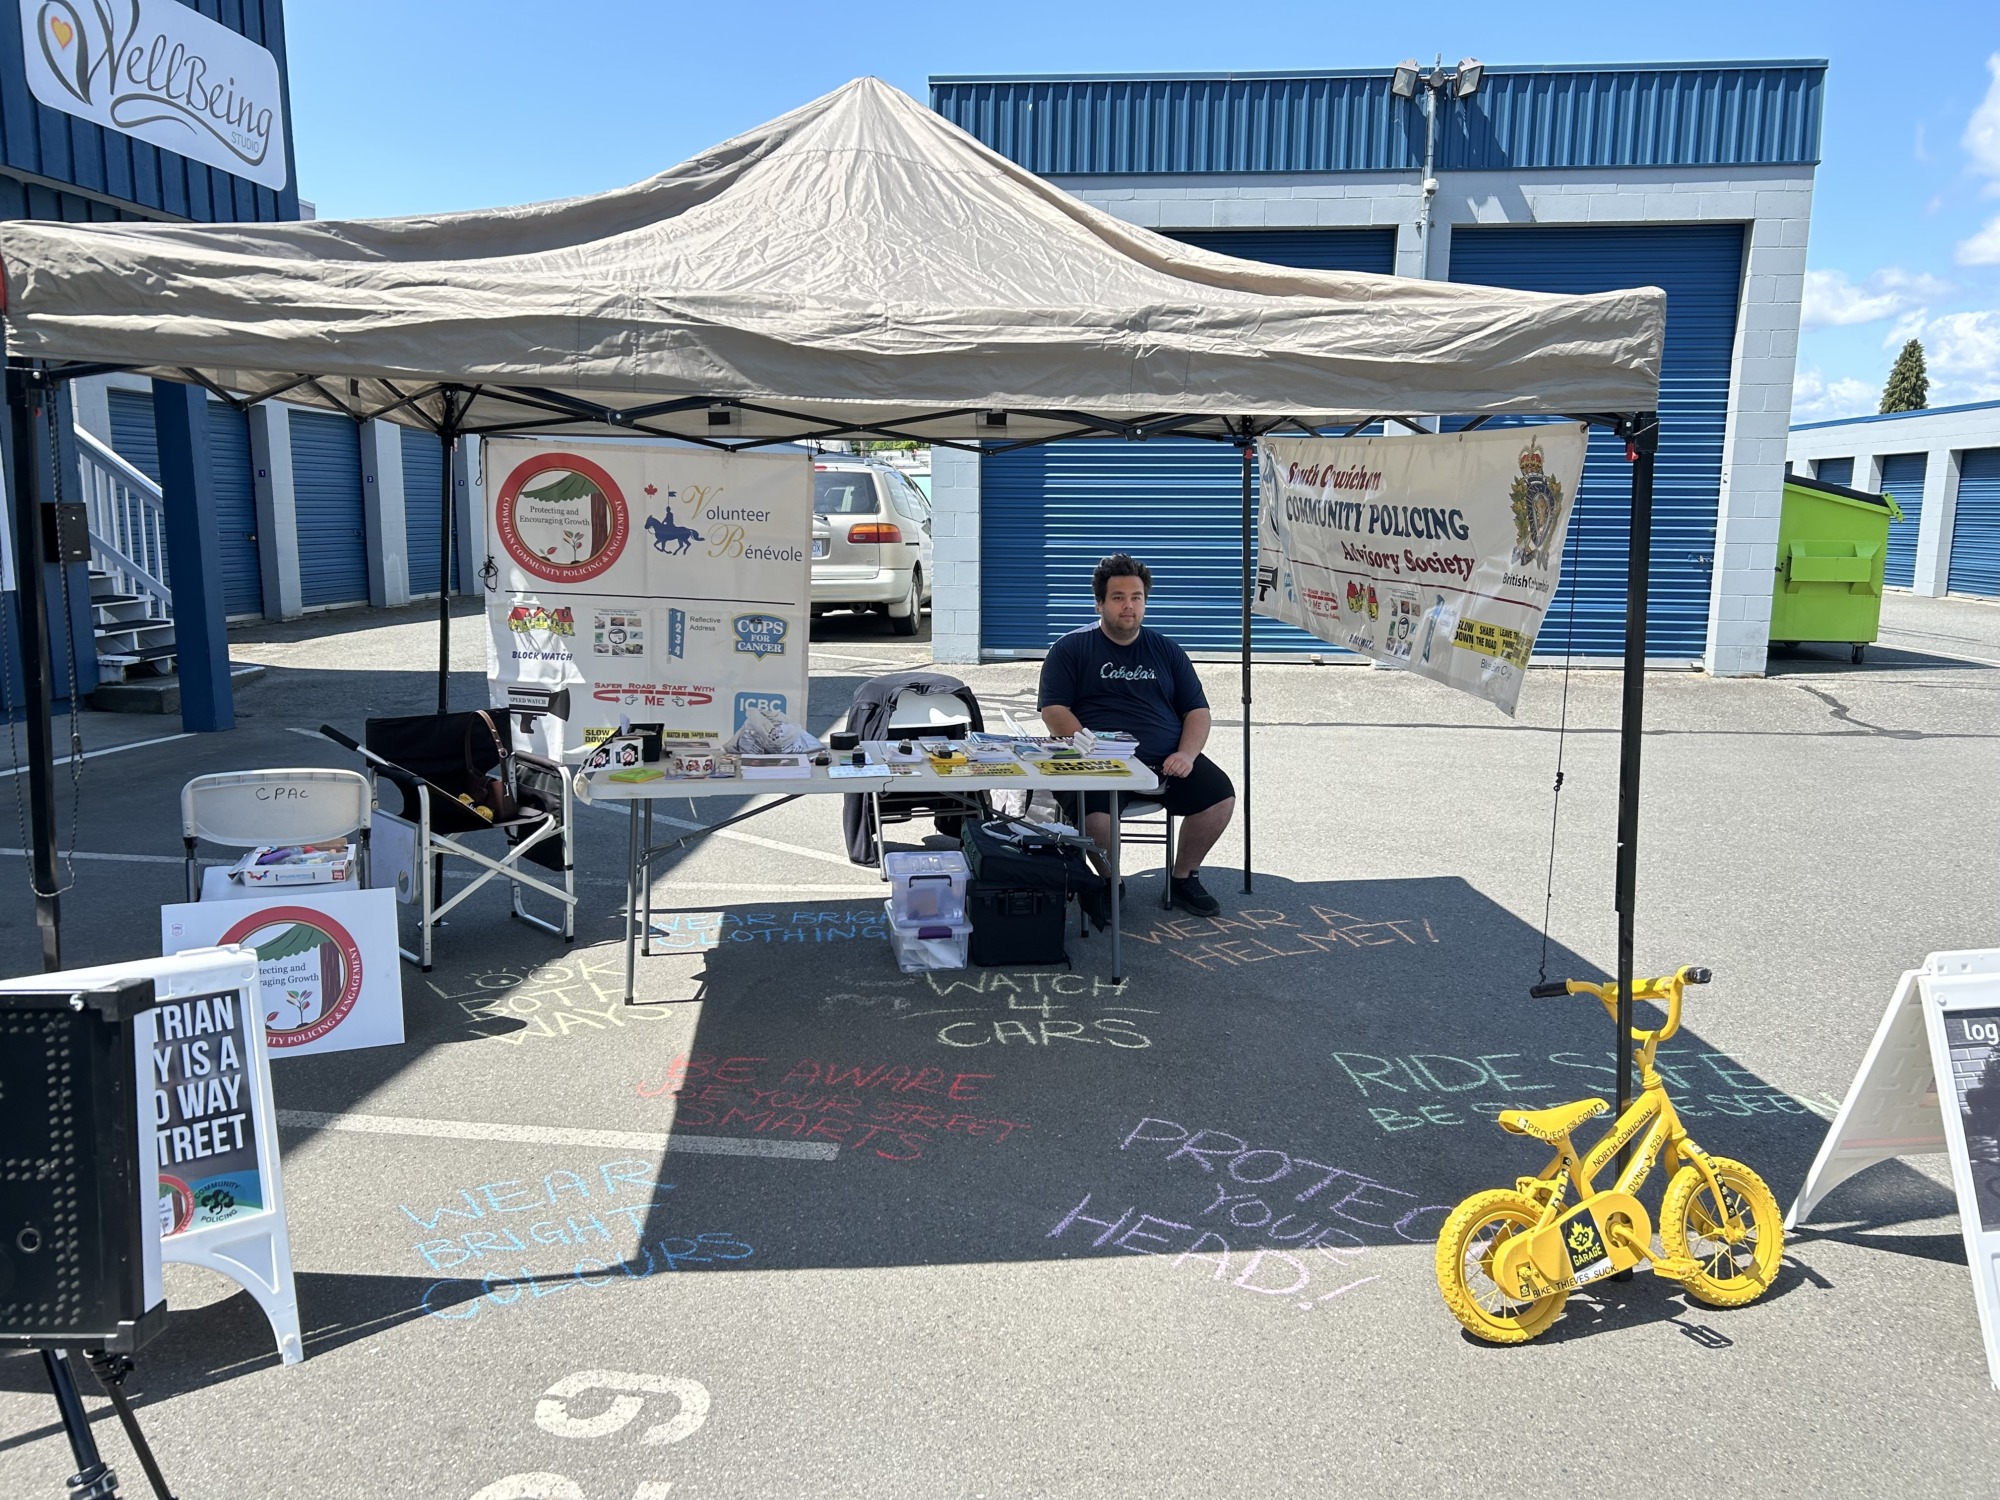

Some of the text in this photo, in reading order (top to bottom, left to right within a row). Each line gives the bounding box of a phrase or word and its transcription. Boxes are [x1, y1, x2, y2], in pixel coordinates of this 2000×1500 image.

[37, 0, 272, 165] WellBeing
[231, 131, 260, 153] STUDIO
[1289, 462, 1382, 491] South Cowichan
[530, 506, 579, 517] Protecting and
[681, 485, 771, 522] Volunteer
[519, 515, 590, 527] Encouraging Growth
[1286, 495, 1470, 541] COMMUNITY POLICING
[502, 496, 626, 577] COWICHAN COMMUNITY POLICING & ENGAGEMENT
[707, 523, 803, 562] Bénévole
[1341, 541, 1475, 582] Advisory Society
[1502, 572, 1528, 588] British
[674, 611, 683, 656] 1234
[689, 616, 721, 624] Reflective
[689, 624, 716, 632] Address
[737, 619, 784, 635] COPS
[1479, 625, 1496, 638] SHARE
[1500, 628, 1513, 637] LEAVE
[737, 641, 782, 653] CANCER
[750, 634, 770, 643] FOR
[1475, 636, 1497, 650] THE ROAD
[512, 650, 573, 661] BLOCK WATCH
[509, 696, 526, 704] SPEED
[644, 695, 665, 706] ME
[739, 697, 782, 712] ICBC
[650, 911, 890, 931] WEAR BRIG
[1119, 905, 1364, 944] WEAR A
[656, 926, 888, 948] CLOTHING
[1168, 918, 1439, 971] HELMET!
[259, 963, 306, 975] tecting and
[260, 973, 320, 987] raging Growth
[425, 958, 627, 999] LOOK
[287, 947, 360, 1044] POLICING & ENGAGEMENT
[925, 971, 1129, 996] WATCH
[458, 981, 638, 1024] BOTH
[1007, 994, 1068, 1018] 4
[153, 995, 235, 1043] TRIAN
[468, 1004, 673, 1045] WAYS
[937, 1018, 1152, 1049] CARS
[182, 1041, 211, 1080] IS
[220, 1035, 240, 1072] A
[666, 1051, 996, 1100] BE AWARE
[1331, 1050, 1555, 1098] RIDE
[177, 1073, 242, 1120] WAY
[675, 1100, 933, 1160] SMARTS
[751, 1087, 863, 1117] YOUR
[870, 1101, 1031, 1145] STREET
[1367, 1104, 1465, 1132] BE
[156, 1112, 247, 1167] TREET
[1527, 1122, 1566, 1140] PROJECT
[1592, 1143, 1618, 1168] NORTH
[1617, 1108, 1653, 1145] COWICHAN
[1649, 1134, 1663, 1151] 529
[194, 1180, 240, 1199] COMMUNITY
[399, 1159, 678, 1230] WEAR
[1120, 1117, 1490, 1256] PROTEC
[200, 1208, 238, 1223] POLICING
[413, 1203, 662, 1270] BRIGHT
[1574, 1231, 1590, 1247] 529
[1572, 1242, 1603, 1267] GARAGE
[422, 1233, 755, 1320] COLOURS
[1532, 1263, 1620, 1299] BIKE THIEVES SUCK.
